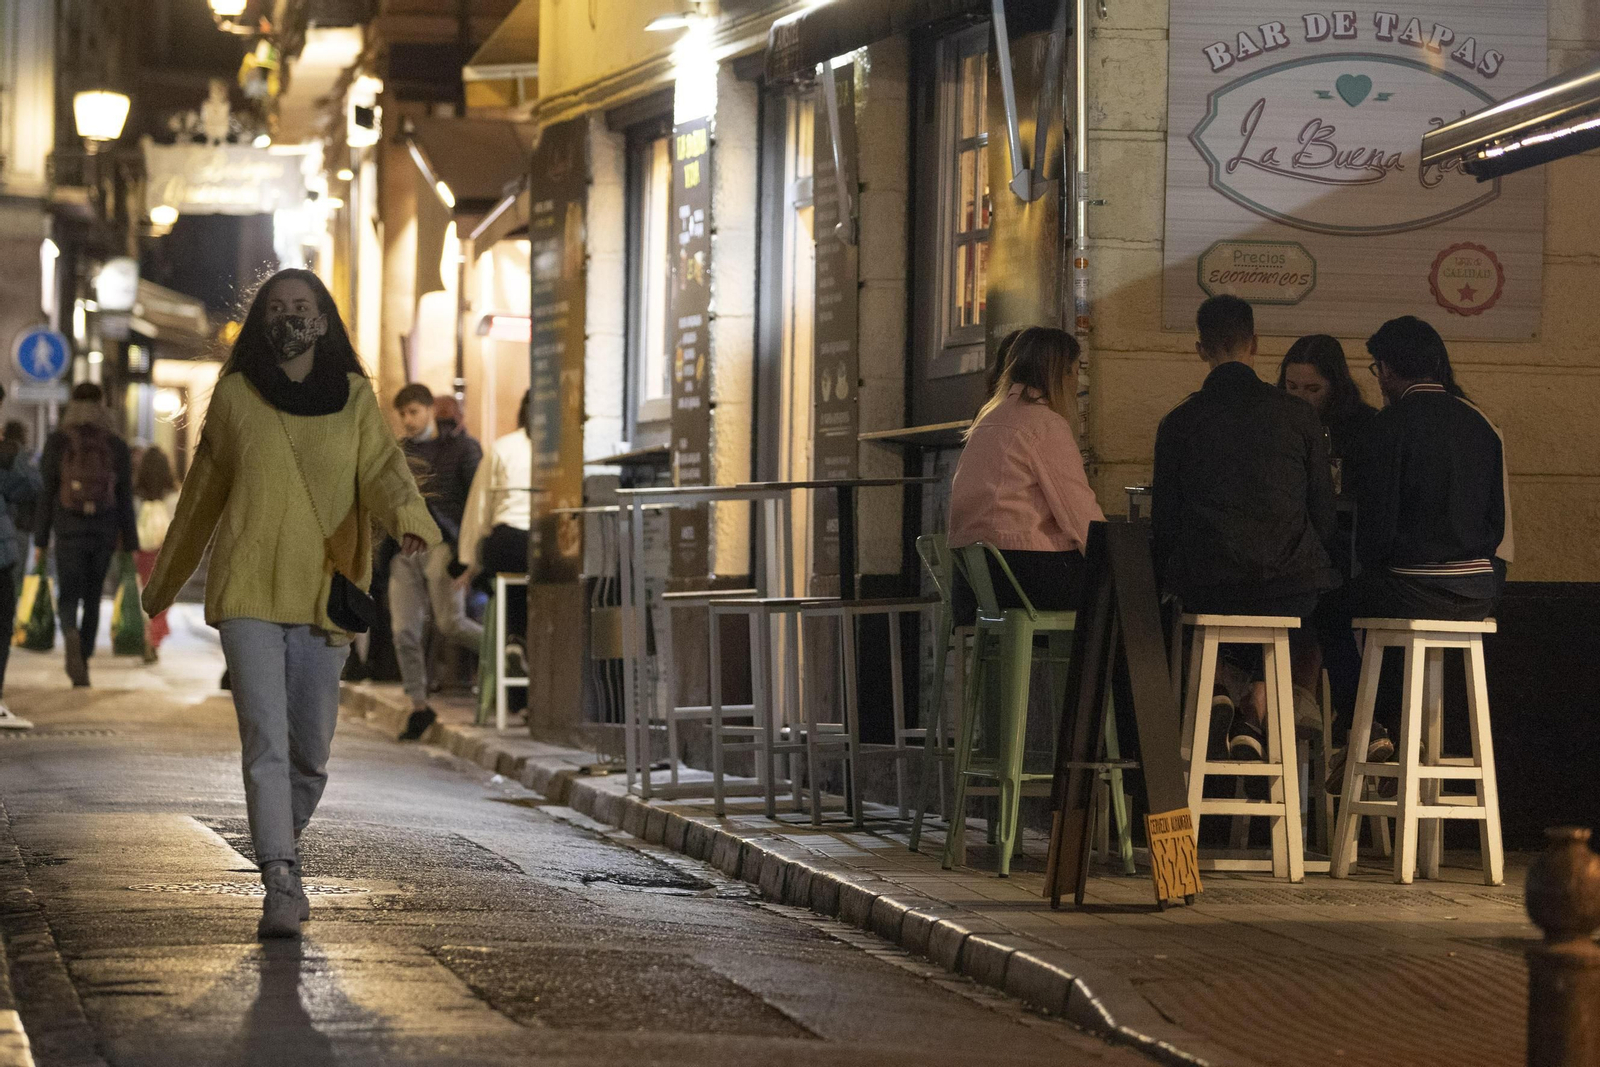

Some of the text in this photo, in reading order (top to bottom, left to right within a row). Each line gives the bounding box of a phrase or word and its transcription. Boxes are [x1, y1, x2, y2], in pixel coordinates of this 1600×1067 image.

[1203, 10, 1505, 78] BAR DE TAPAS
[1226, 97, 1281, 174] La
[1291, 117, 1405, 170] Buena
[1233, 249, 1286, 265] Precios
